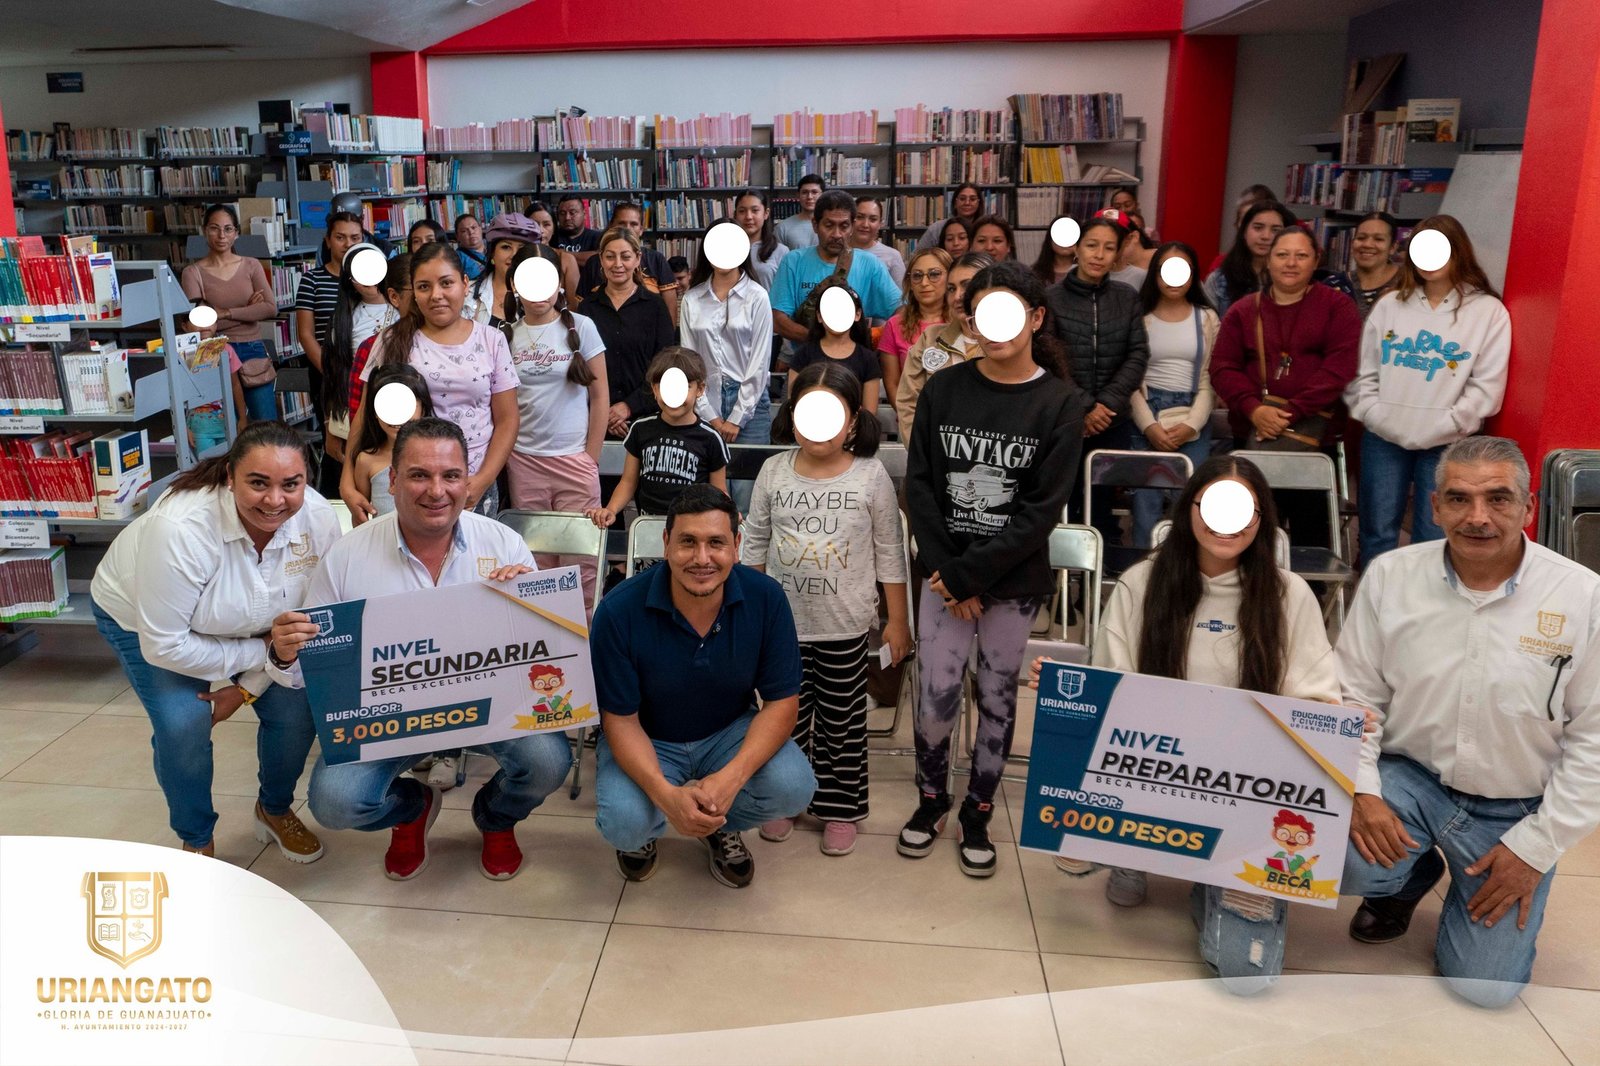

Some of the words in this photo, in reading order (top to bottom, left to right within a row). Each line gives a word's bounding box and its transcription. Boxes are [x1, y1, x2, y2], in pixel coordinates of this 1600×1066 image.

[659, 437, 684, 446] 1898
[966, 428, 1007, 441] CLASSIC
[940, 432, 1037, 469] VINTAGE
[642, 445, 657, 475] LOS
[656, 445, 699, 482] ANGELES
[791, 516, 839, 535] YOU
[777, 536, 850, 570] CAN
[517, 578, 556, 589] EDUCACIÓN
[525, 583, 557, 593] CIVISMO
[781, 573, 839, 596] EVEN
[305, 634, 353, 649] RIANGATO
[372, 638, 440, 662] NIVEL
[1519, 635, 1573, 653] URIANGATO
[371, 639, 550, 685] SECUNDARIA
[371, 686, 406, 697] BECA
[412, 671, 497, 691] EXCELENCIA
[326, 707, 369, 722] BUENO
[371, 703, 402, 716] POR:
[1040, 697, 1097, 714] URIANGATO
[333, 720, 400, 744] 3,000
[406, 706, 479, 732] PESOS
[537, 710, 573, 723] BECA
[1292, 710, 1338, 723] EDUCACIÓN
[1300, 718, 1337, 730] CIVISMO
[1108, 728, 1185, 757] NIVEL
[1099, 752, 1327, 809] PREPARATORIA
[1040, 785, 1087, 803] BUENO
[1089, 793, 1122, 809] POR:
[1096, 776, 1133, 788] BECA
[1141, 784, 1237, 807] EXCELENCIA
[1040, 805, 1114, 834] 6,000
[1119, 819, 1205, 850] PESOS
[1267, 871, 1311, 890] BECA
